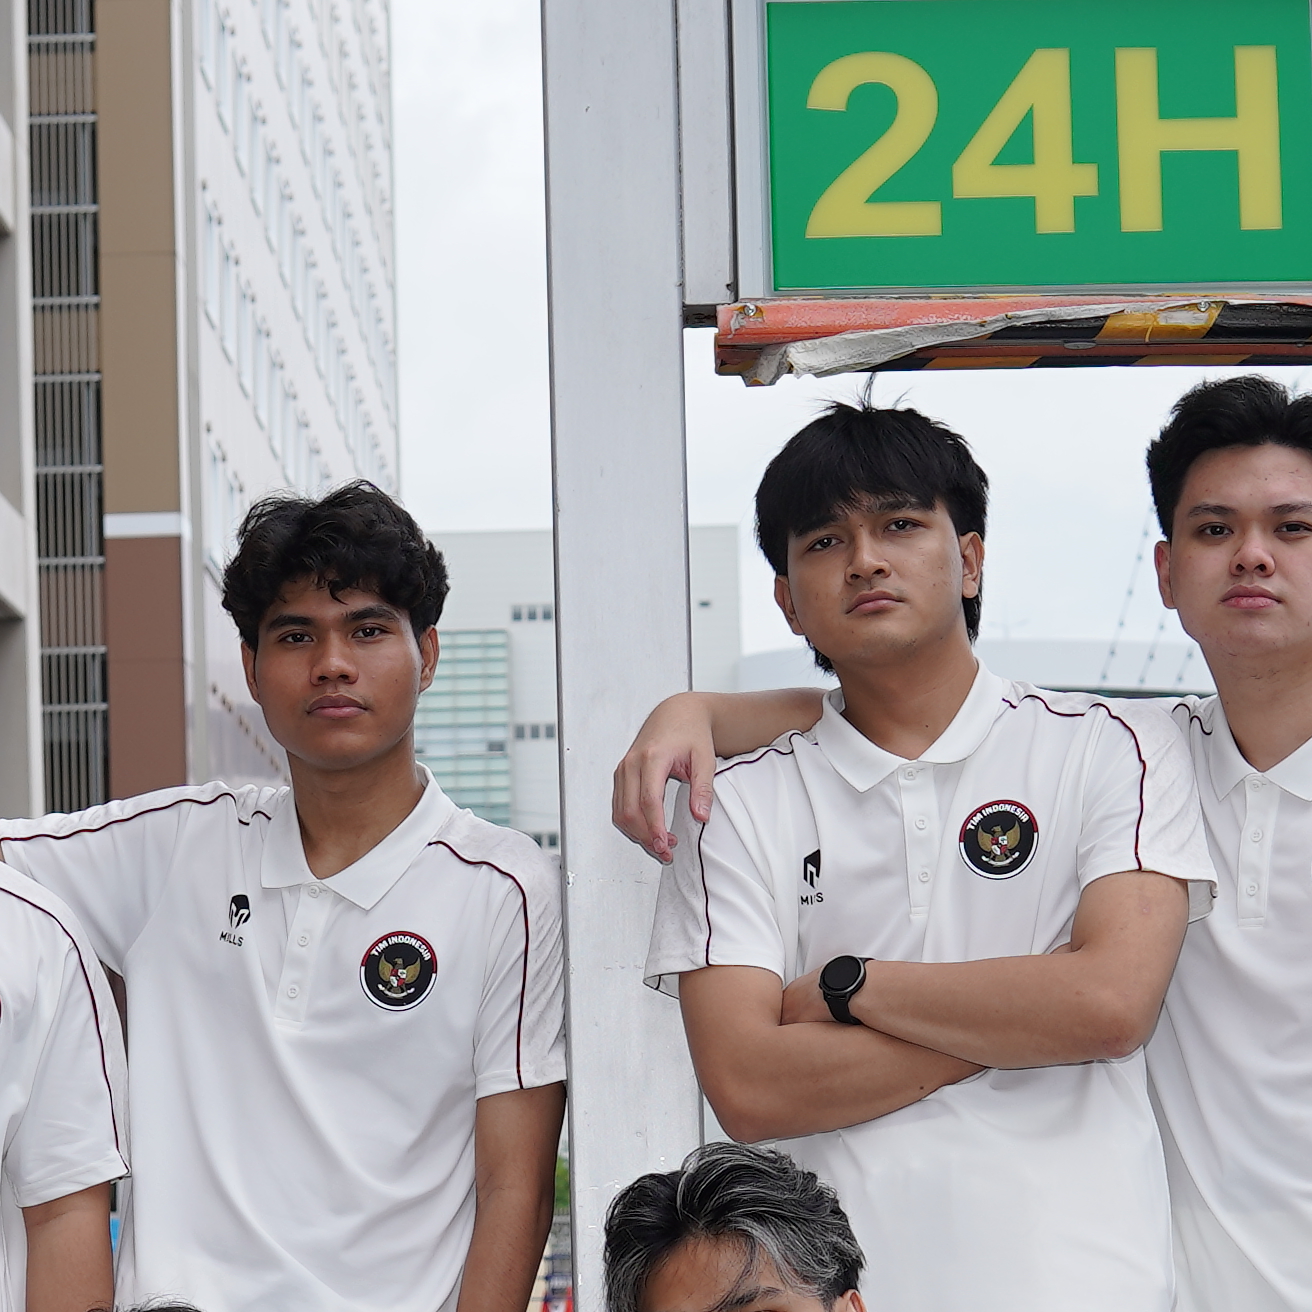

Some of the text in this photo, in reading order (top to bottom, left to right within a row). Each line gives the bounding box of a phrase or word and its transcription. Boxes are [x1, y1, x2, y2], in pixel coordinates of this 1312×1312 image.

[804, 44, 1283, 238] 24H
[966, 803, 1030, 830] TIM INDONESIA
[370, 935, 432, 961] TIM INDONESIA
